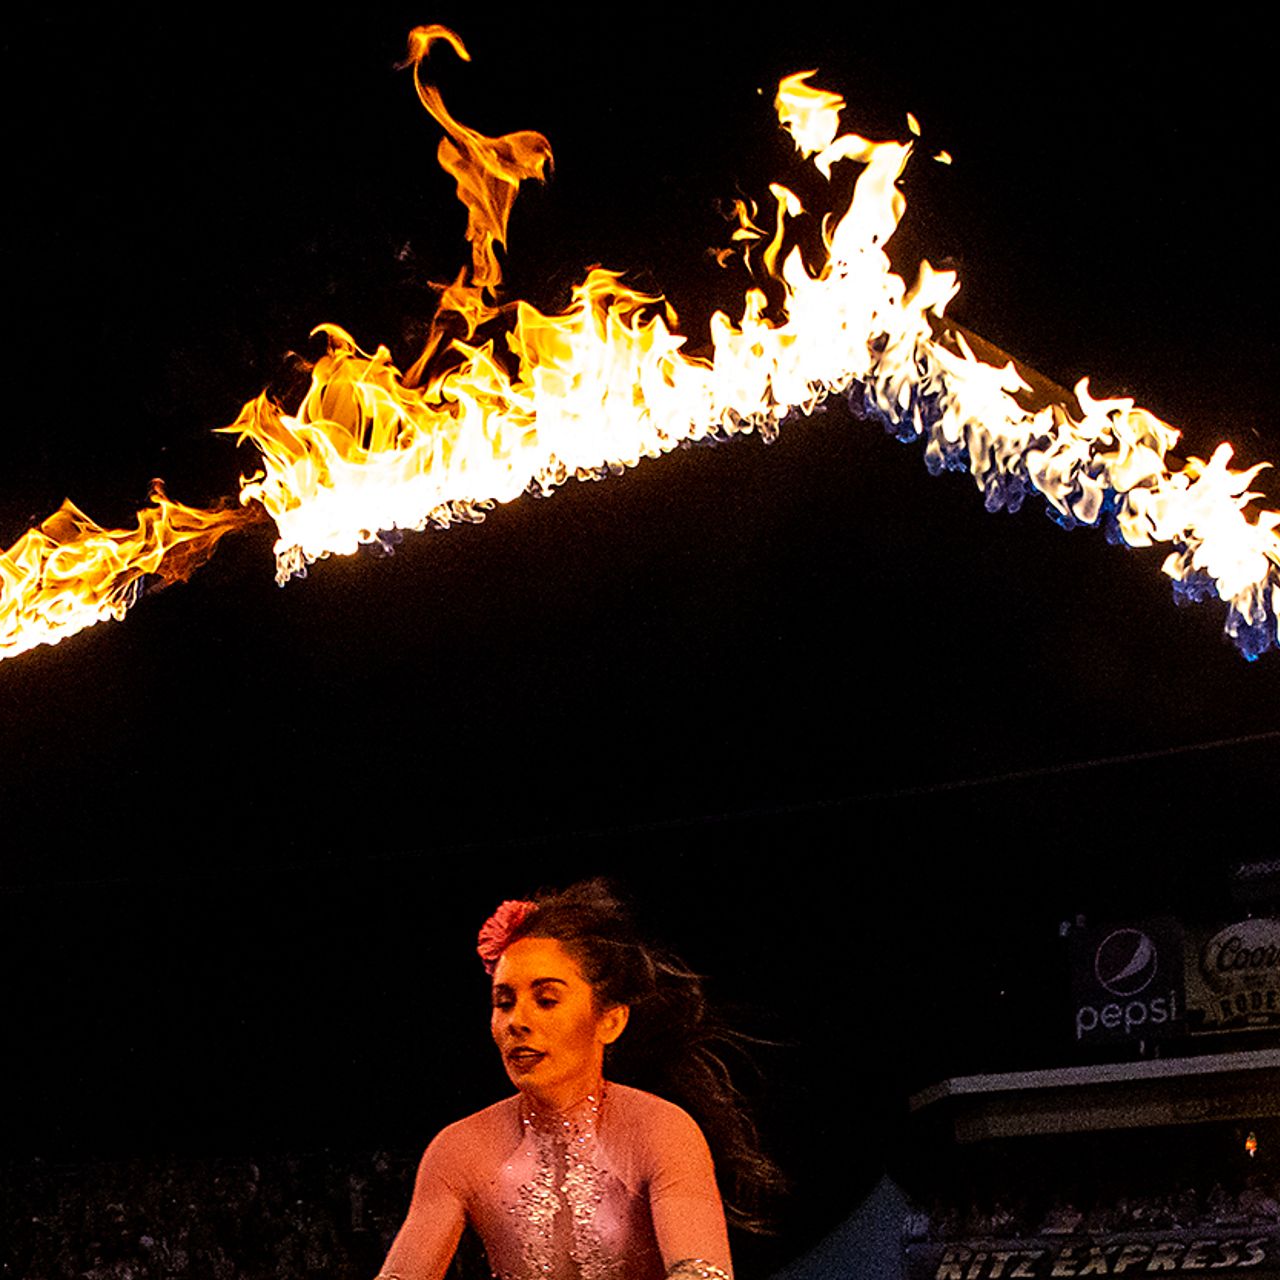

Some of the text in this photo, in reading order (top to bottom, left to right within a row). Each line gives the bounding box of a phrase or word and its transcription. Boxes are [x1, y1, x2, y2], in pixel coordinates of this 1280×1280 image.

[1077, 990, 1177, 1040] pepsi
[935, 1237, 1268, 1280] RITZ EXPRESS
